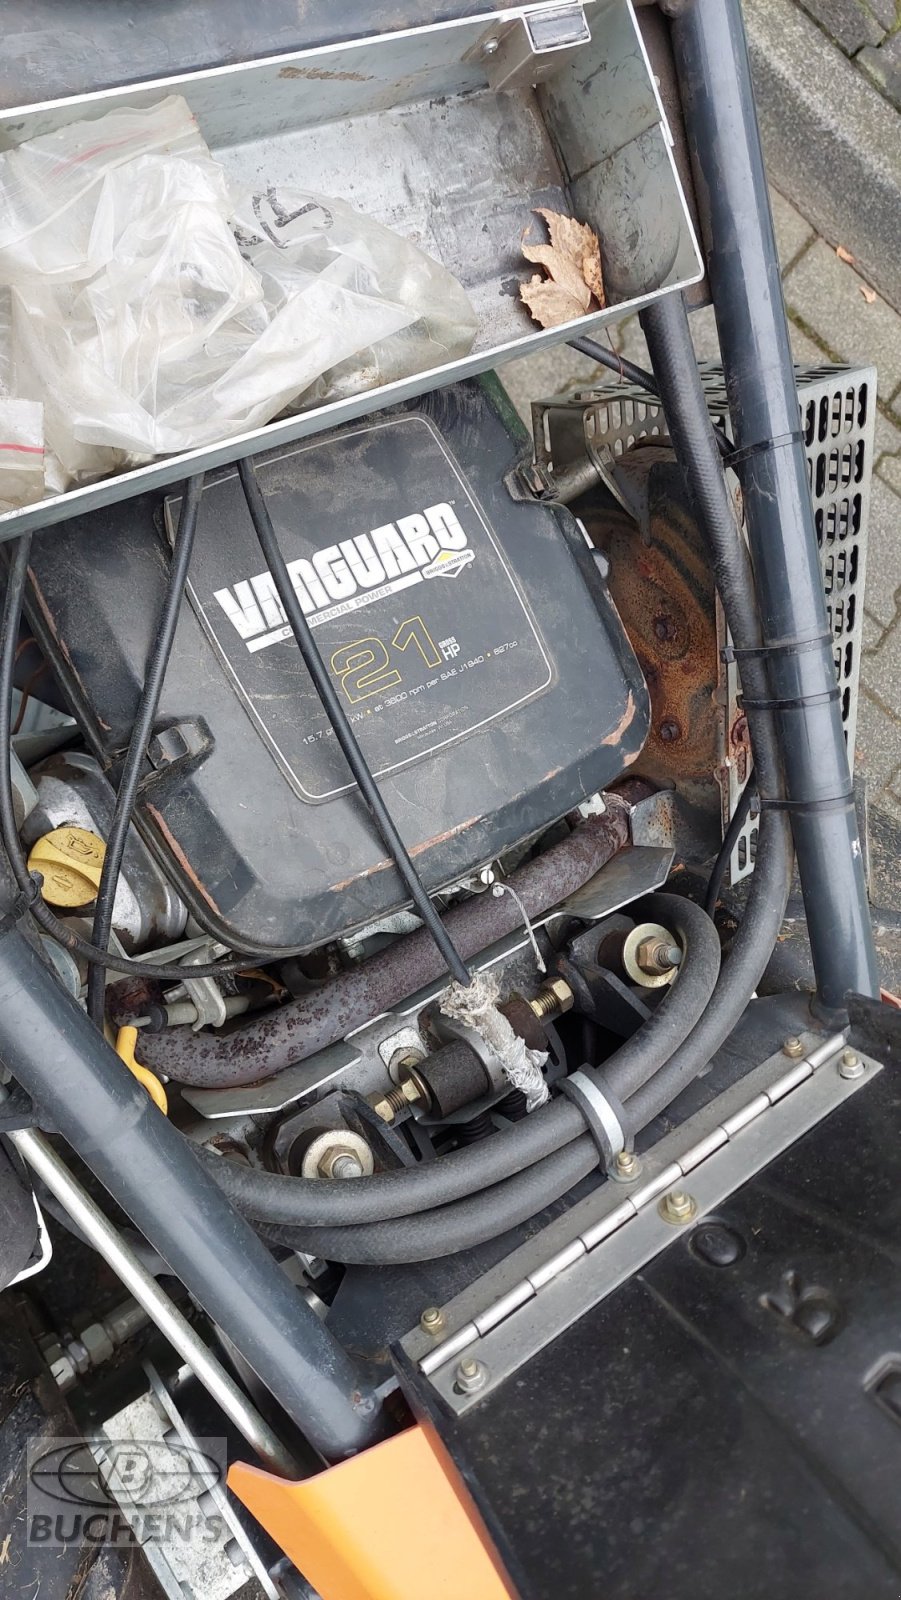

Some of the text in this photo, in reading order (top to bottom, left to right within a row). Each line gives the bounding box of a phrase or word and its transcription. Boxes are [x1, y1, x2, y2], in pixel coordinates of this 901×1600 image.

[213, 502, 467, 639] VANGUARD
[281, 585, 393, 637] CMERCIAL POWER
[331, 615, 461, 704] 21 HP
[302, 730, 323, 745] 15.7
[409, 685, 426, 696] rpm
[426, 678, 439, 689] per
[440, 668, 458, 681] SAE
